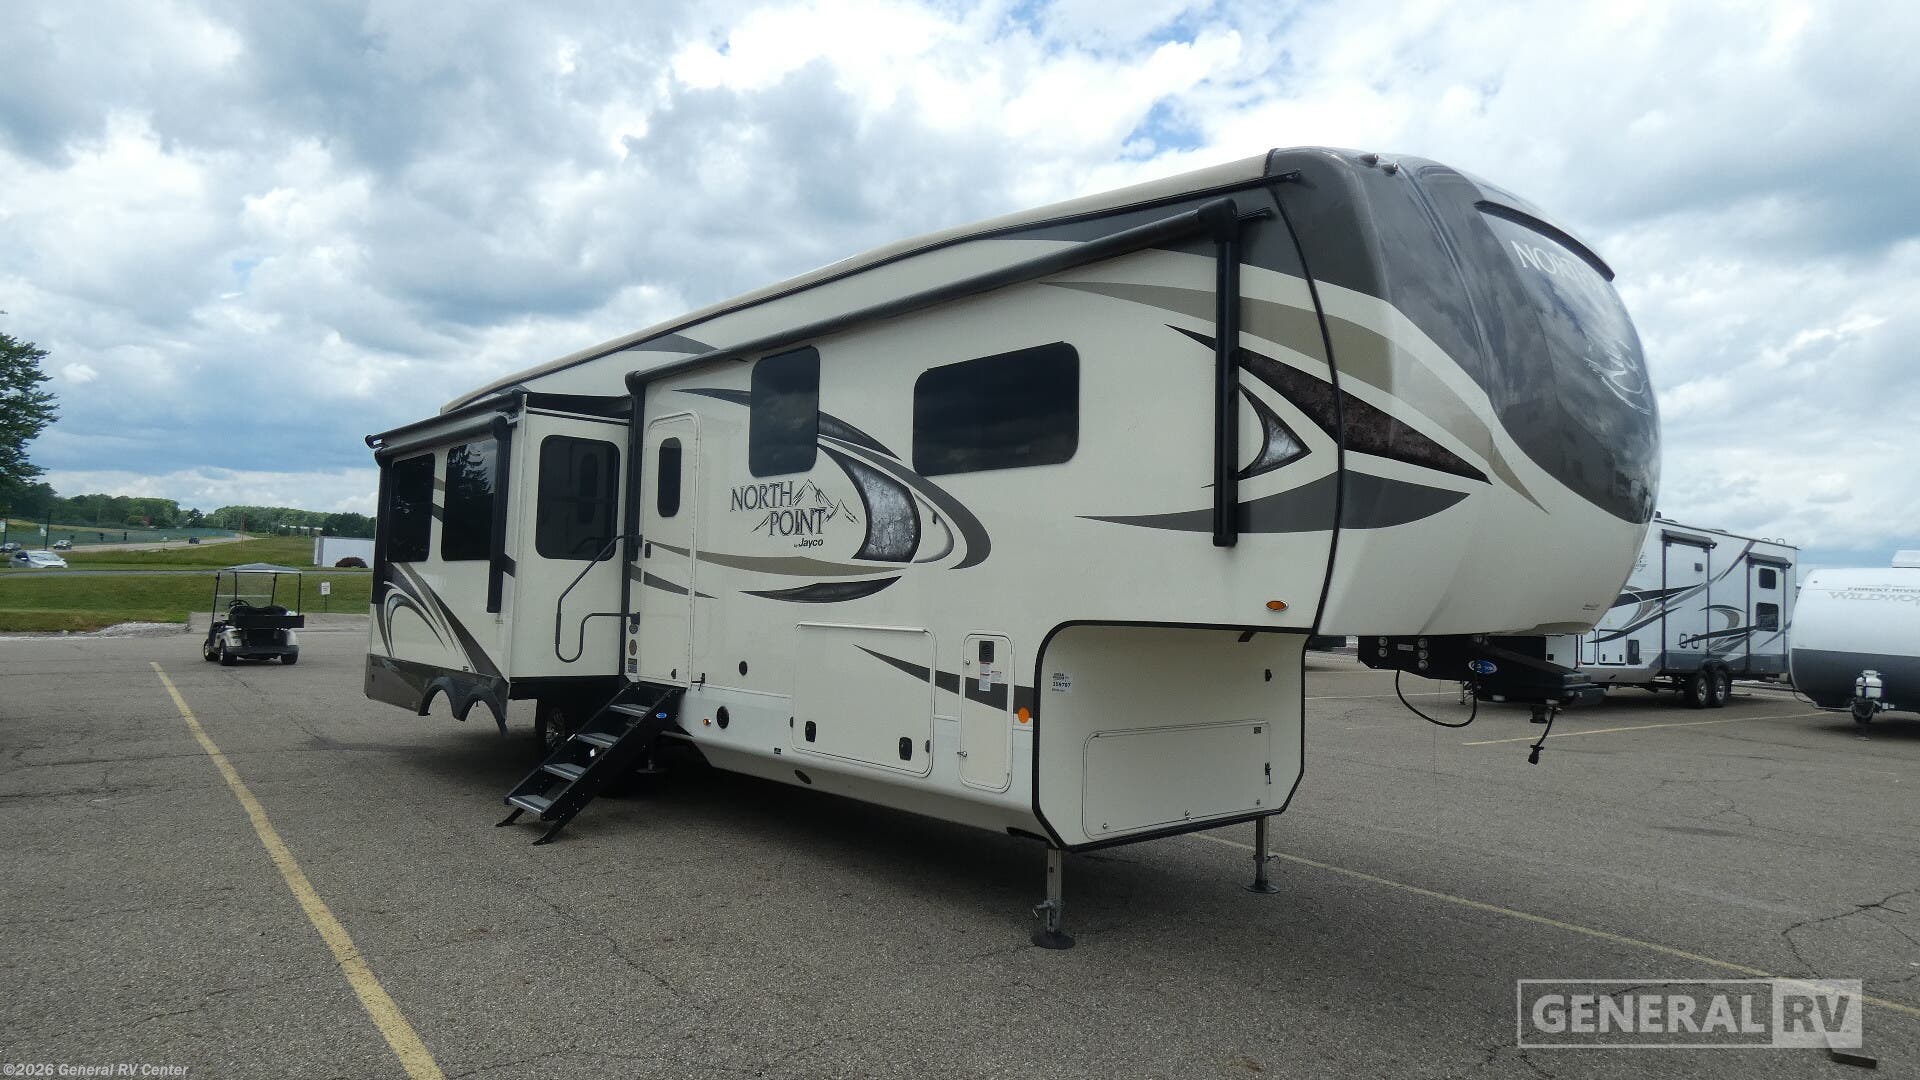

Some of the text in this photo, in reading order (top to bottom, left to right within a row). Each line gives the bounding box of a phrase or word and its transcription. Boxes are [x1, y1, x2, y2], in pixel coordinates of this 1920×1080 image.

[730, 480, 794, 512] NORTH
[768, 507, 827, 537] POINT
[798, 537, 824, 549] Jayco
